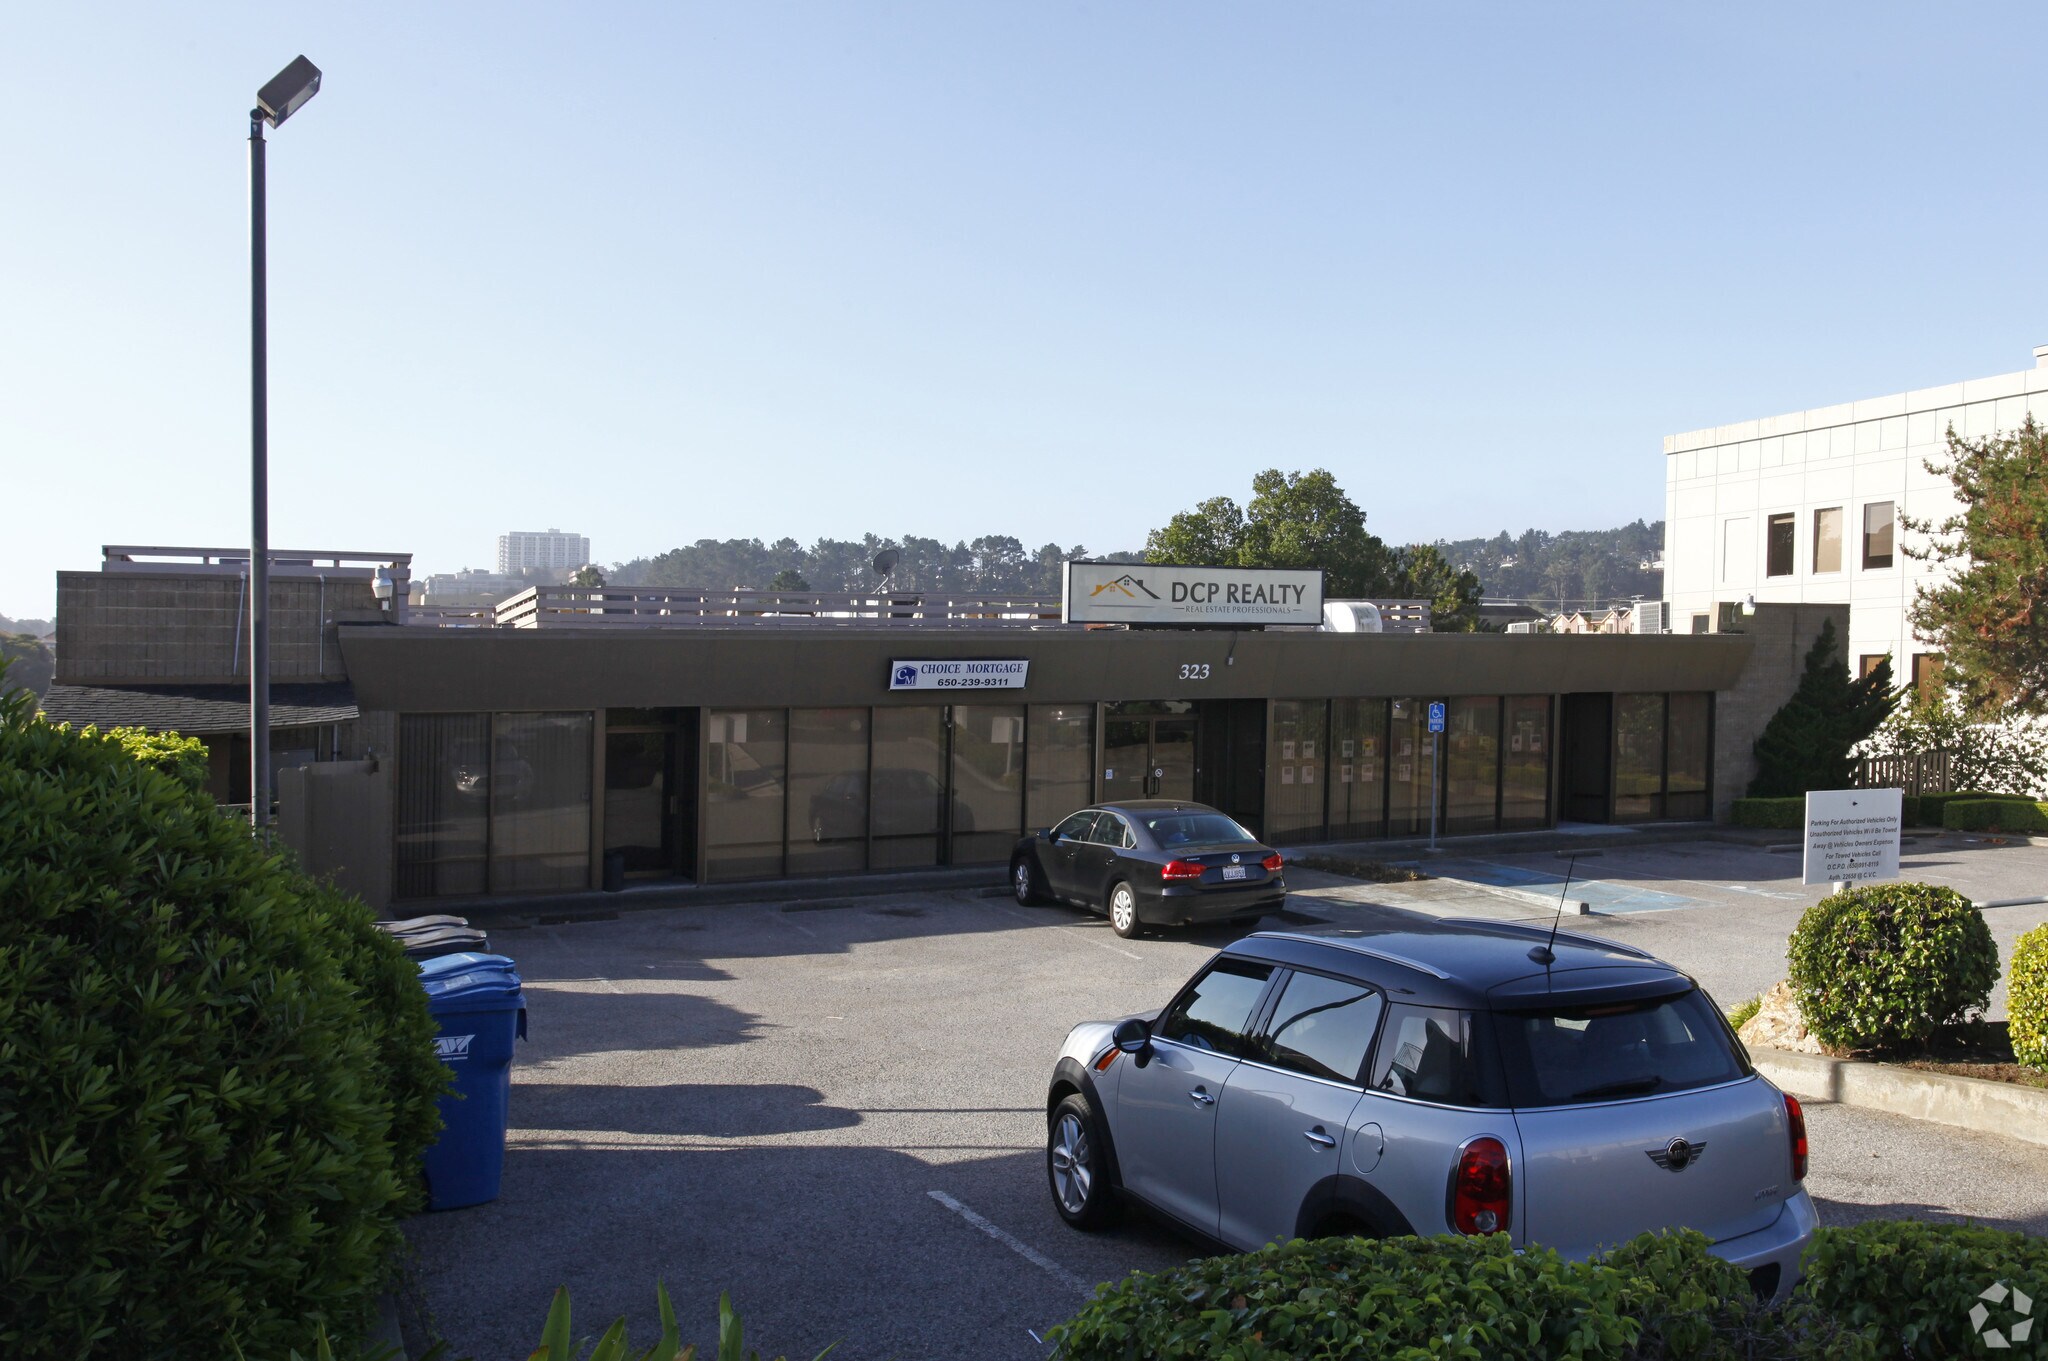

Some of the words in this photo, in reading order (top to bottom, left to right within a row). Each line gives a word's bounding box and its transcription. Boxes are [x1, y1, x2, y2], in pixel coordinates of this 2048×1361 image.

[1171, 582, 1219, 603] DCP
[1226, 584, 1306, 604] REALTY
[1185, 604, 1203, 613] REAL
[1205, 605, 1231, 613] ESTATE
[1232, 606, 1291, 614] PROFESSIONALS
[921, 663, 961, 674] CHOICE
[966, 663, 1024, 674] MORTGAGE
[1178, 664, 1211, 680] 323
[937, 678, 1009, 687] 650-239-9311
